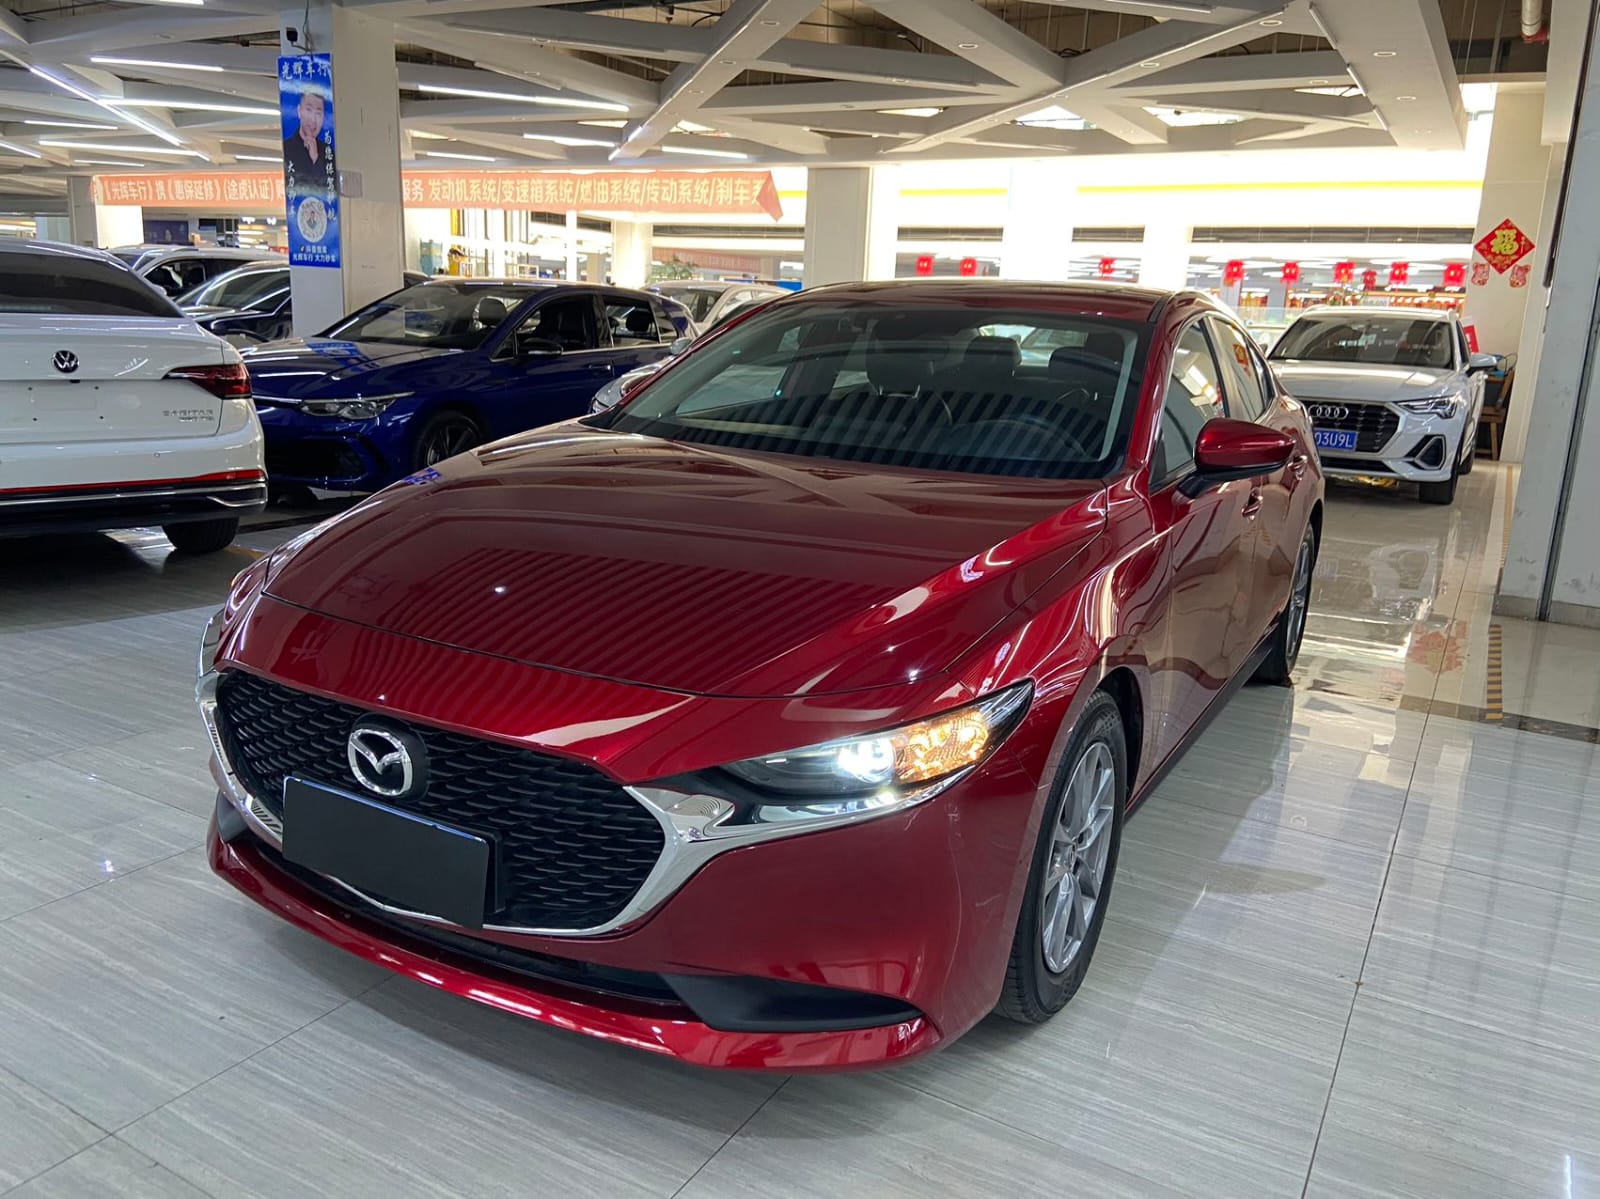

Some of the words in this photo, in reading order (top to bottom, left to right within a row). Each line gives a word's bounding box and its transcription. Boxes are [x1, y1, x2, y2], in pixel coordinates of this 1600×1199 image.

[282, 61, 325, 80] 光辉车行
[1490, 229, 1519, 255] 福
